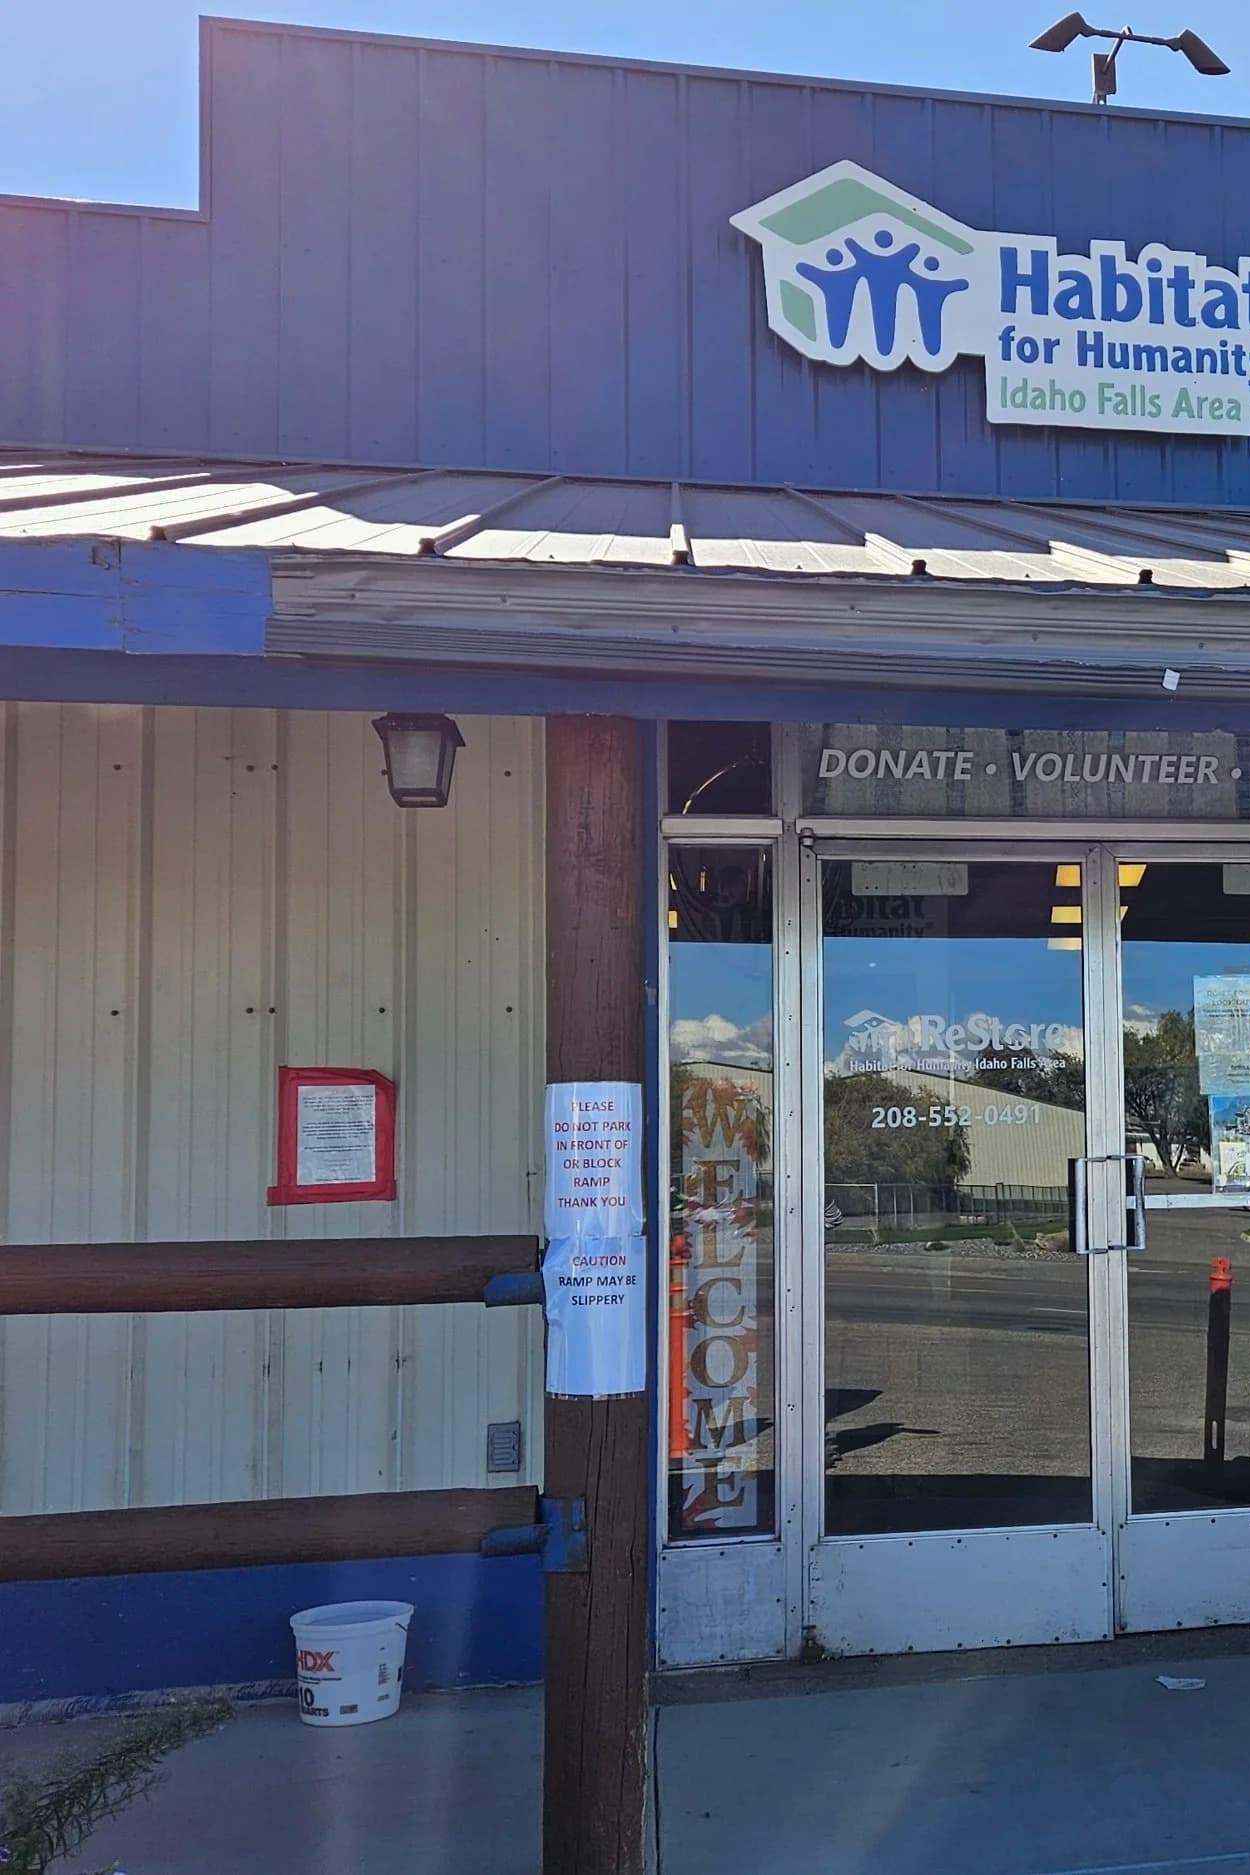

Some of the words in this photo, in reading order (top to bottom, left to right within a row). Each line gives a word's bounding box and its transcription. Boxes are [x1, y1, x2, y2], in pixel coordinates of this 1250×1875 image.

[999, 326, 1060, 364] for
[1000, 377, 1086, 413] Idaho
[1099, 383, 1161, 417] Falls
[1172, 388, 1242, 421] Area
[818, 749, 974, 780] DONATE
[1011, 752, 1219, 784] VOLUNTEER
[919, 1012, 1062, 1052] ReStore
[976, 1057, 1007, 1070] Idaho
[1011, 1057, 1037, 1070] Falls
[871, 1103, 1041, 1129] 208-552-0491
[554, 1121, 569, 1133] DO
[572, 1121, 599, 1132] NOT
[602, 1120, 631, 1132] PARK
[556, 1140, 567, 1151] IN
[570, 1139, 611, 1151] FRONT
[614, 1139, 629, 1150] OF
[563, 1158, 579, 1169] OR
[582, 1158, 622, 1169] BLOCK
[573, 1176, 610, 1188] RAMP
[558, 1196, 597, 1208] THANK
[600, 1196, 626, 1207] YOU
[572, 1255, 626, 1267] CAUTION
[558, 1275, 593, 1287] RAMP
[596, 1275, 624, 1287] MAY
[625, 1274, 637, 1286] BE
[571, 1294, 625, 1306] SLIPPERY
[689, 1097, 751, 1509] WELCOME
